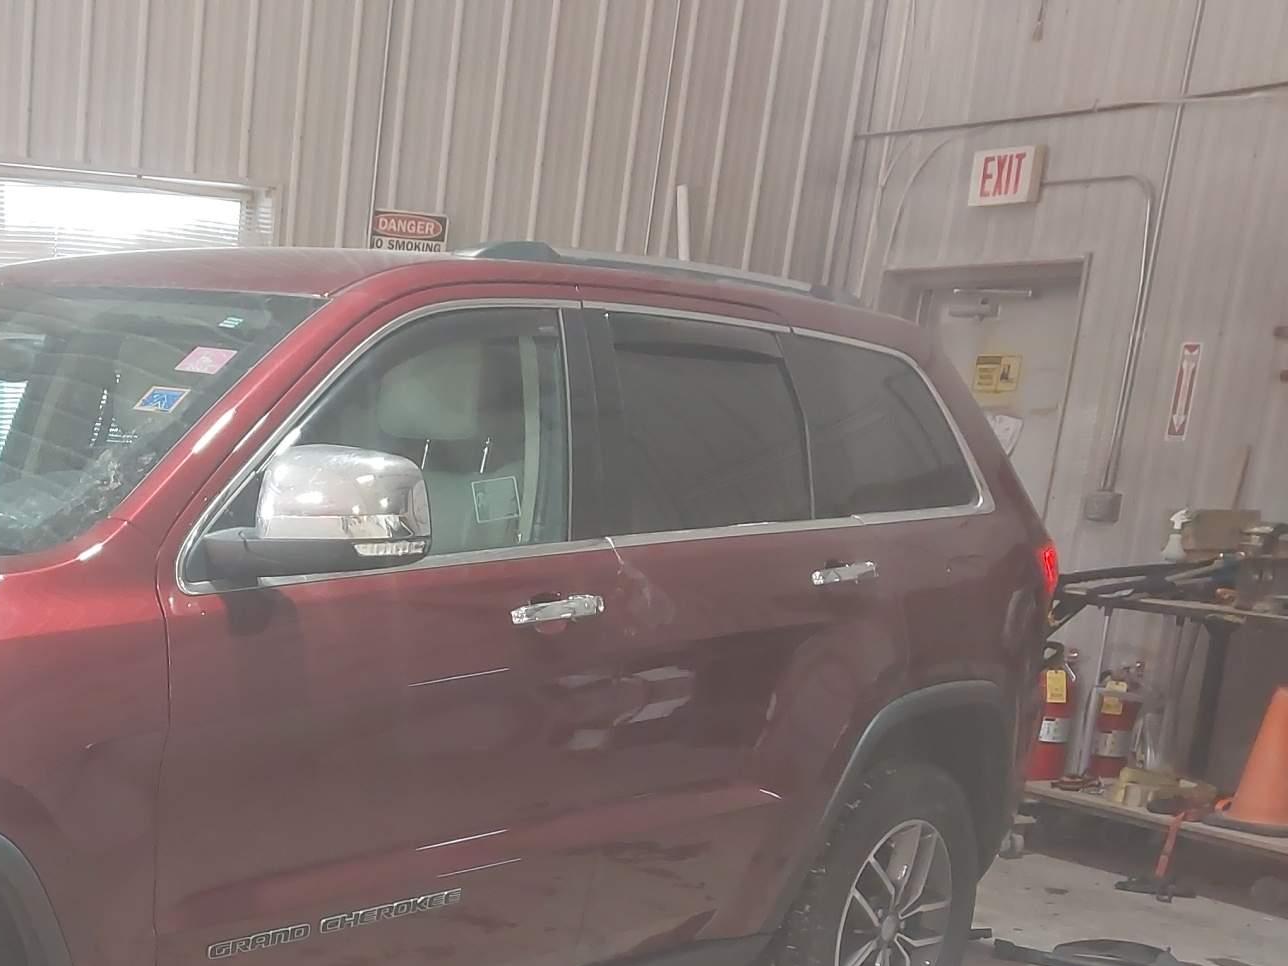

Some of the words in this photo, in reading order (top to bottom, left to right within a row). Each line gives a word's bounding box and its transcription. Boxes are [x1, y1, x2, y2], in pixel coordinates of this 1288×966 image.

[979, 152, 1027, 198] EXIT
[378, 218, 435, 235] DANGER
[387, 239, 441, 253] SMOKING
[208, 924, 311, 960] GRAND
[320, 888, 462, 934] CHEROKEE
